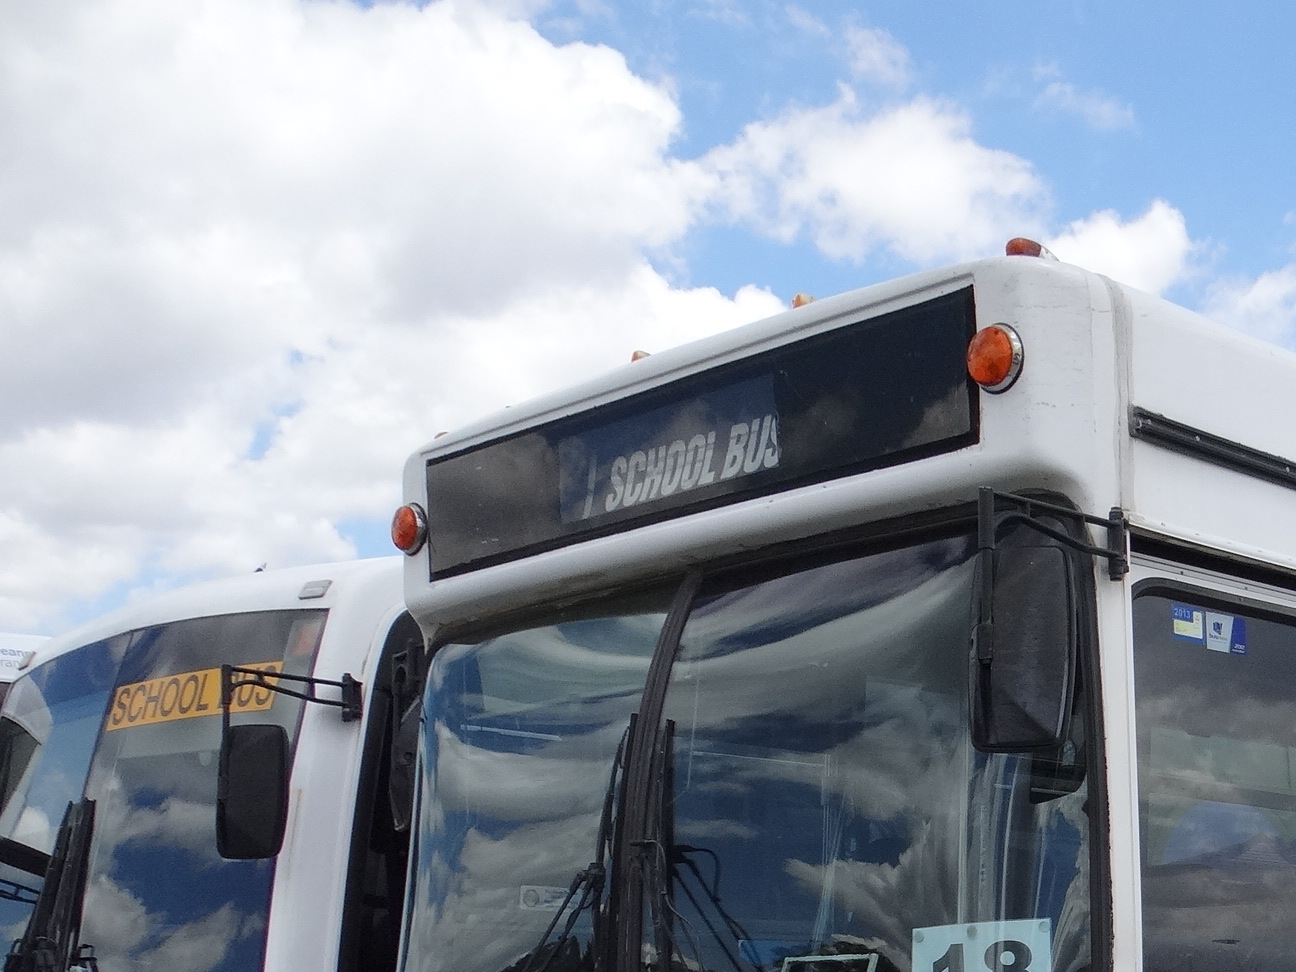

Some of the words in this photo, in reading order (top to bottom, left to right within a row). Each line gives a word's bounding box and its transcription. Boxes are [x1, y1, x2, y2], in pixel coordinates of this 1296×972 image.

[605, 430, 717, 513] SCHOOL
[720, 413, 780, 481] BUS
[1172, 608, 1191, 619] 2013
[112, 673, 209, 726] SCHOOL
